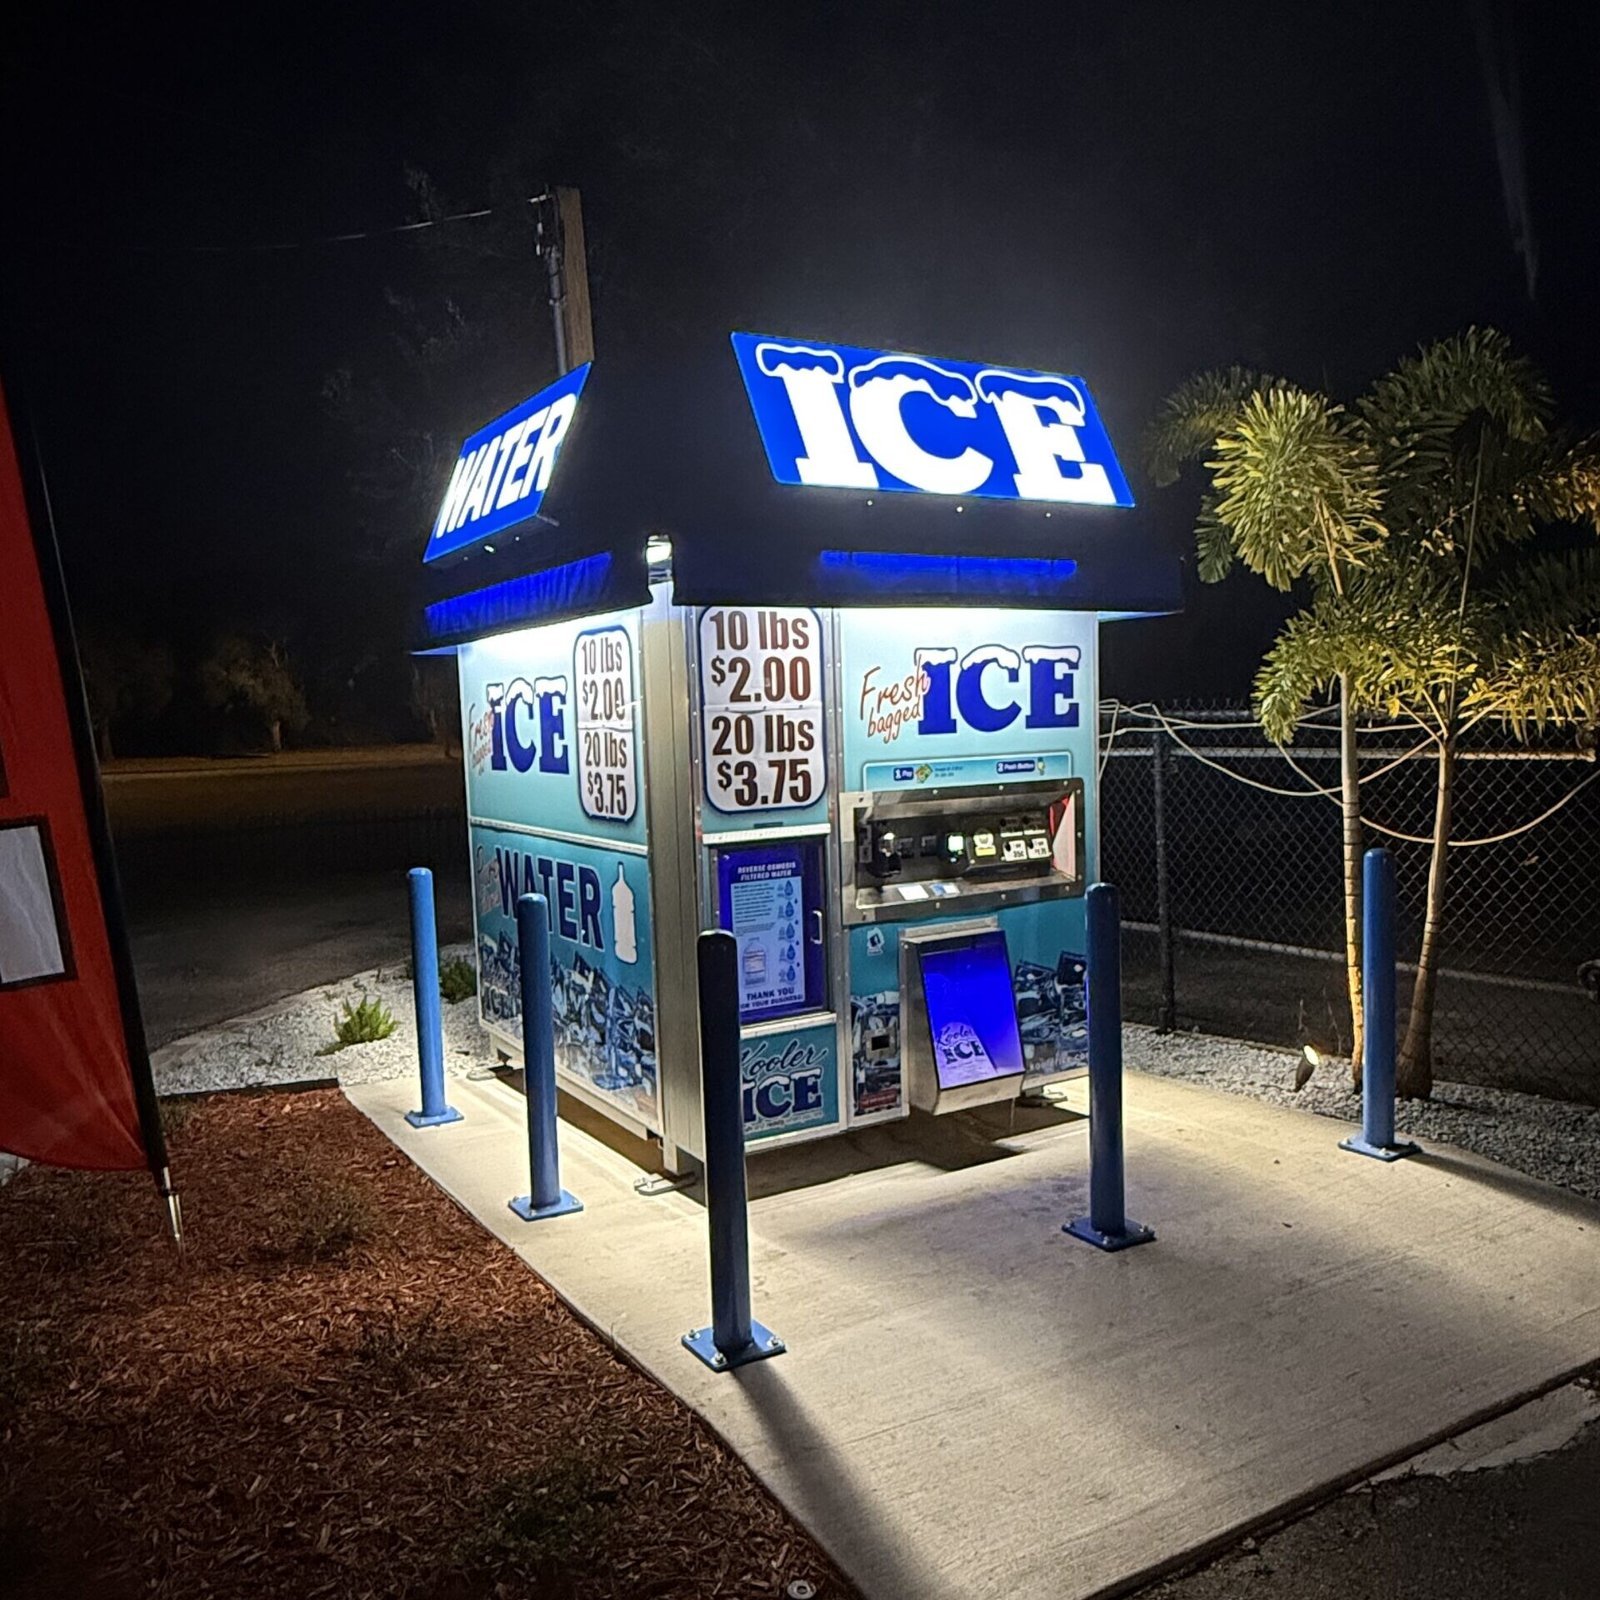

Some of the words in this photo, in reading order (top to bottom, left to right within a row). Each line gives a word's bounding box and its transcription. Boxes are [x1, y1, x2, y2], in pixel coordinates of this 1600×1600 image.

[756, 343, 1117, 503] ICE
[436, 393, 577, 538] WATER
[710, 611, 748, 651] 10
[758, 611, 810, 650] lbs
[582, 639, 597, 675] 10
[601, 637, 622, 673] lbs
[712, 655, 811, 703] $2.00
[583, 678, 625, 721] $2.00
[860, 653, 929, 720] Fresh
[914, 644, 1081, 735] ICE
[486, 675, 570, 774] ICE
[712, 714, 754, 756] 20
[764, 714, 815, 753] lbs
[867, 695, 920, 744] bagged
[585, 731, 601, 767] 20
[604, 732, 627, 769] lbs
[588, 773, 627, 816] $3.75
[717, 758, 812, 807] $3.75
[740, 871, 770, 881] FILTERED
[747, 989, 774, 1000] THANK
[777, 986, 795, 996] YOU
[742, 1067, 823, 1122] ICE
